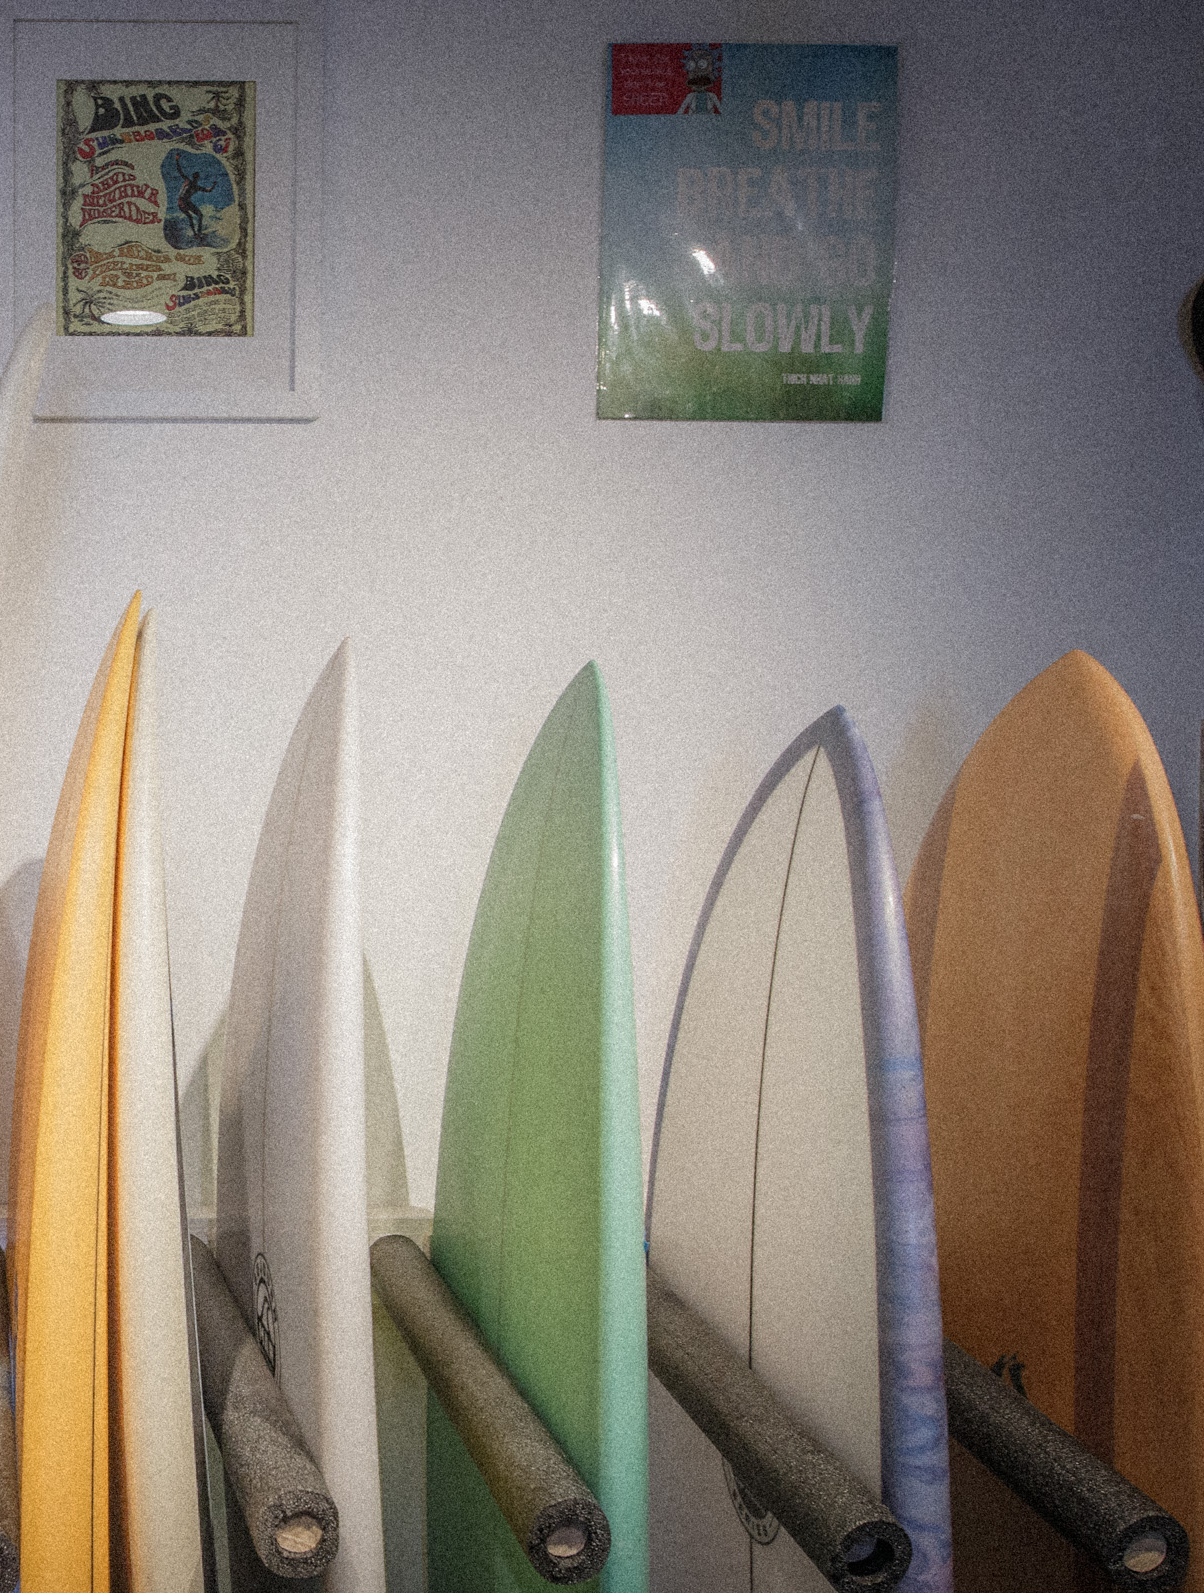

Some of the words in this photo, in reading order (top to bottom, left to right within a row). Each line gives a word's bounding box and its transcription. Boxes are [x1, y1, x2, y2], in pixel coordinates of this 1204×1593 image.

[77, 113, 212, 159] SURFBOARDS
[85, 92, 181, 135] BING
[753, 99, 881, 151] SMILE
[677, 166, 879, 219] BREATHE
[178, 274, 230, 293] BING
[694, 302, 874, 353] SLOWLY
